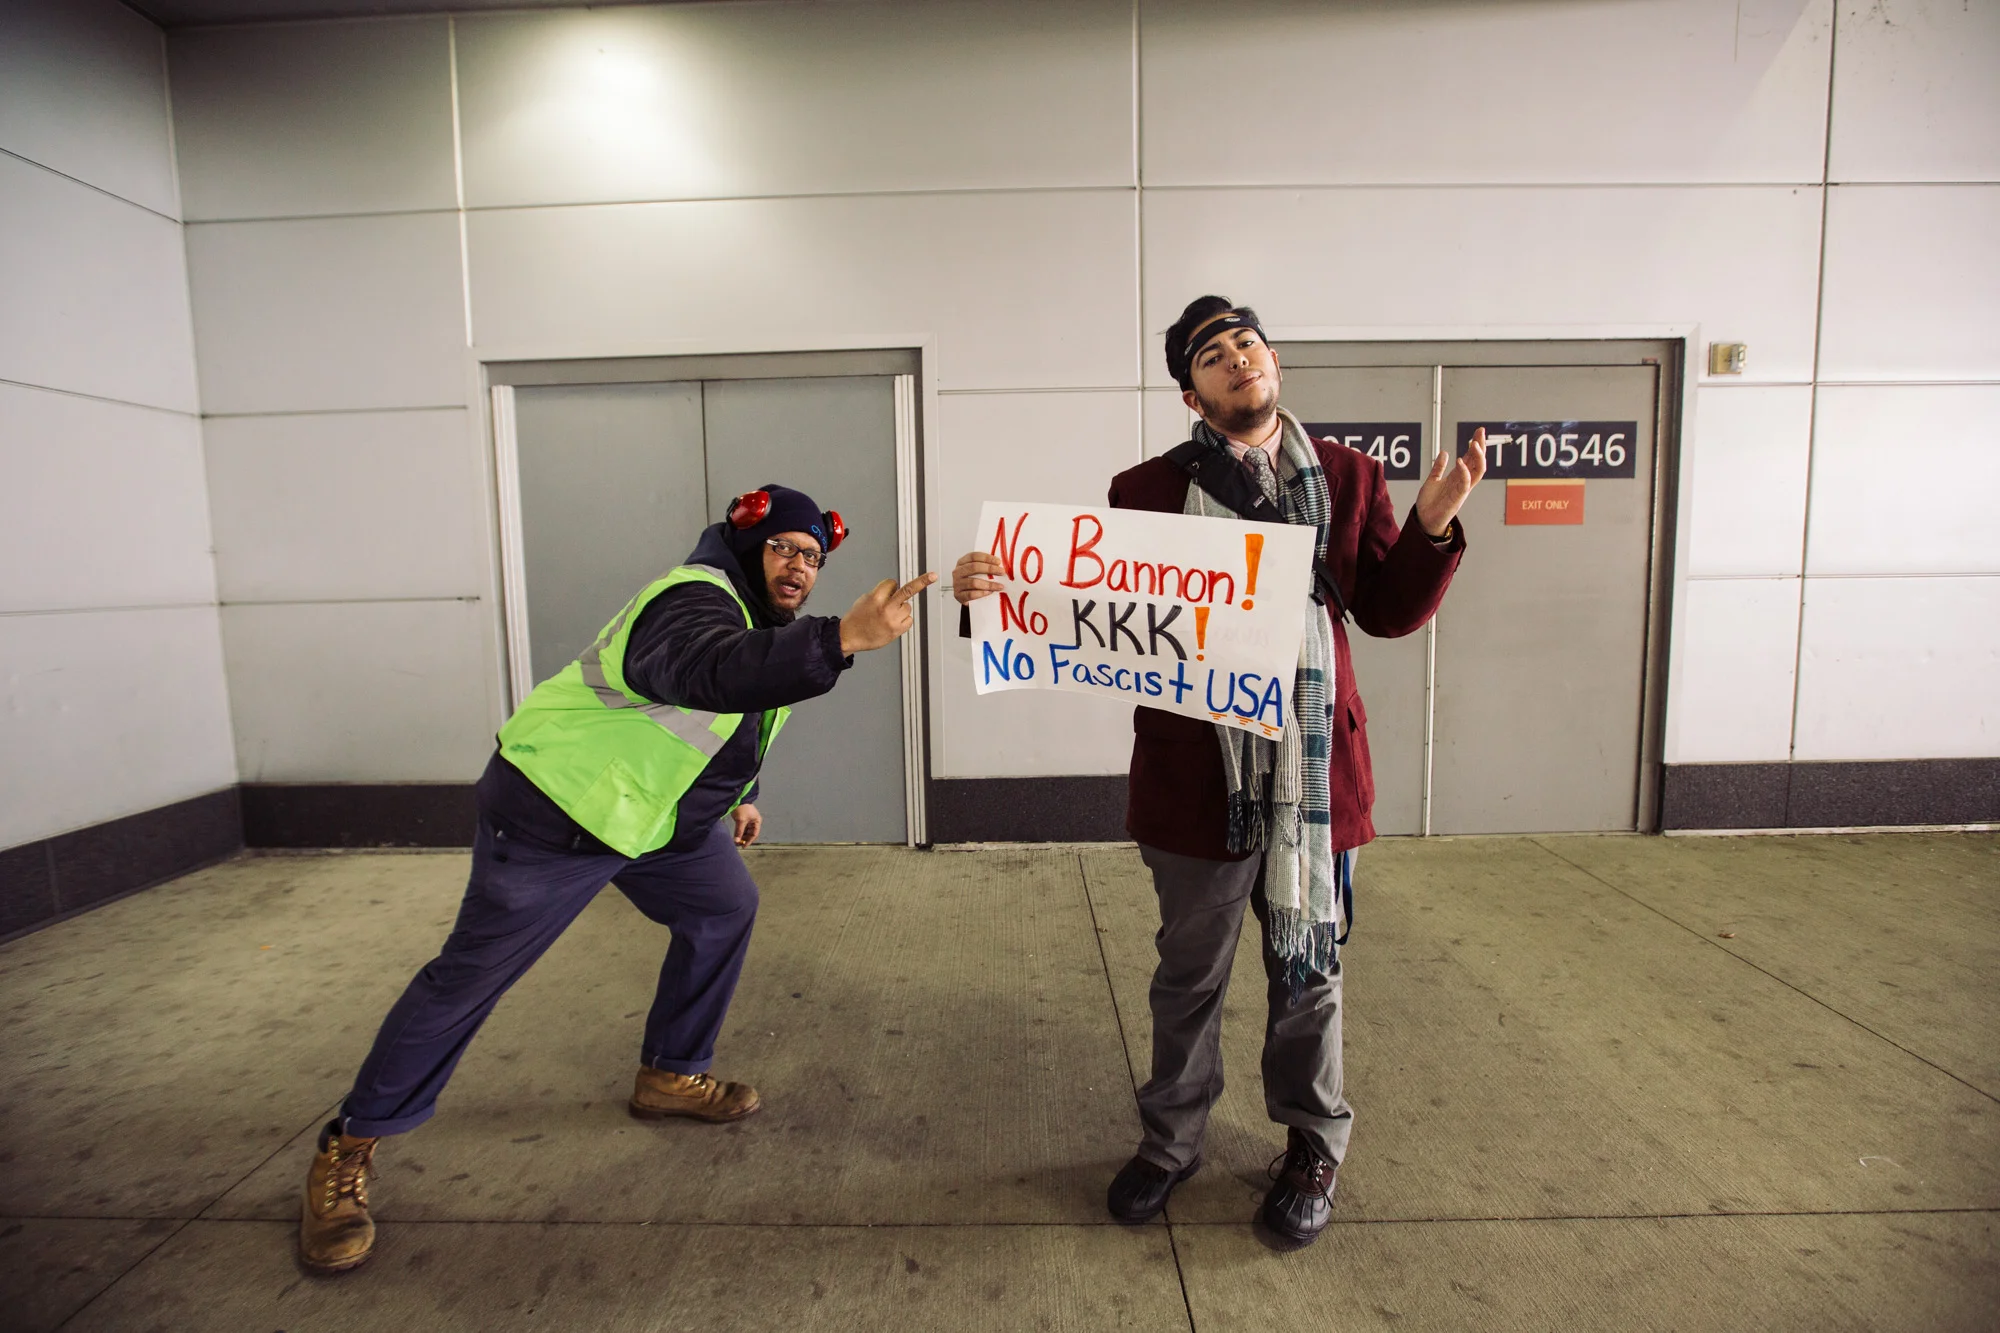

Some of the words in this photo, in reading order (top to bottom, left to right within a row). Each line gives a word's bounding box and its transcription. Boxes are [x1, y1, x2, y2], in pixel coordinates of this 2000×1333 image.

[1322, 435, 1411, 468] 546
[1521, 500, 1542, 510] EXIT
[1545, 500, 1569, 510] ONLY
[987, 512, 1043, 584] No
[1059, 514, 1264, 611] Bannon!
[999, 591, 1048, 636] No
[1072, 599, 1211, 662] KKK!
[982, 638, 1035, 686] No
[1049, 642, 1194, 704] Fascist
[1205, 668, 1284, 728] USA
